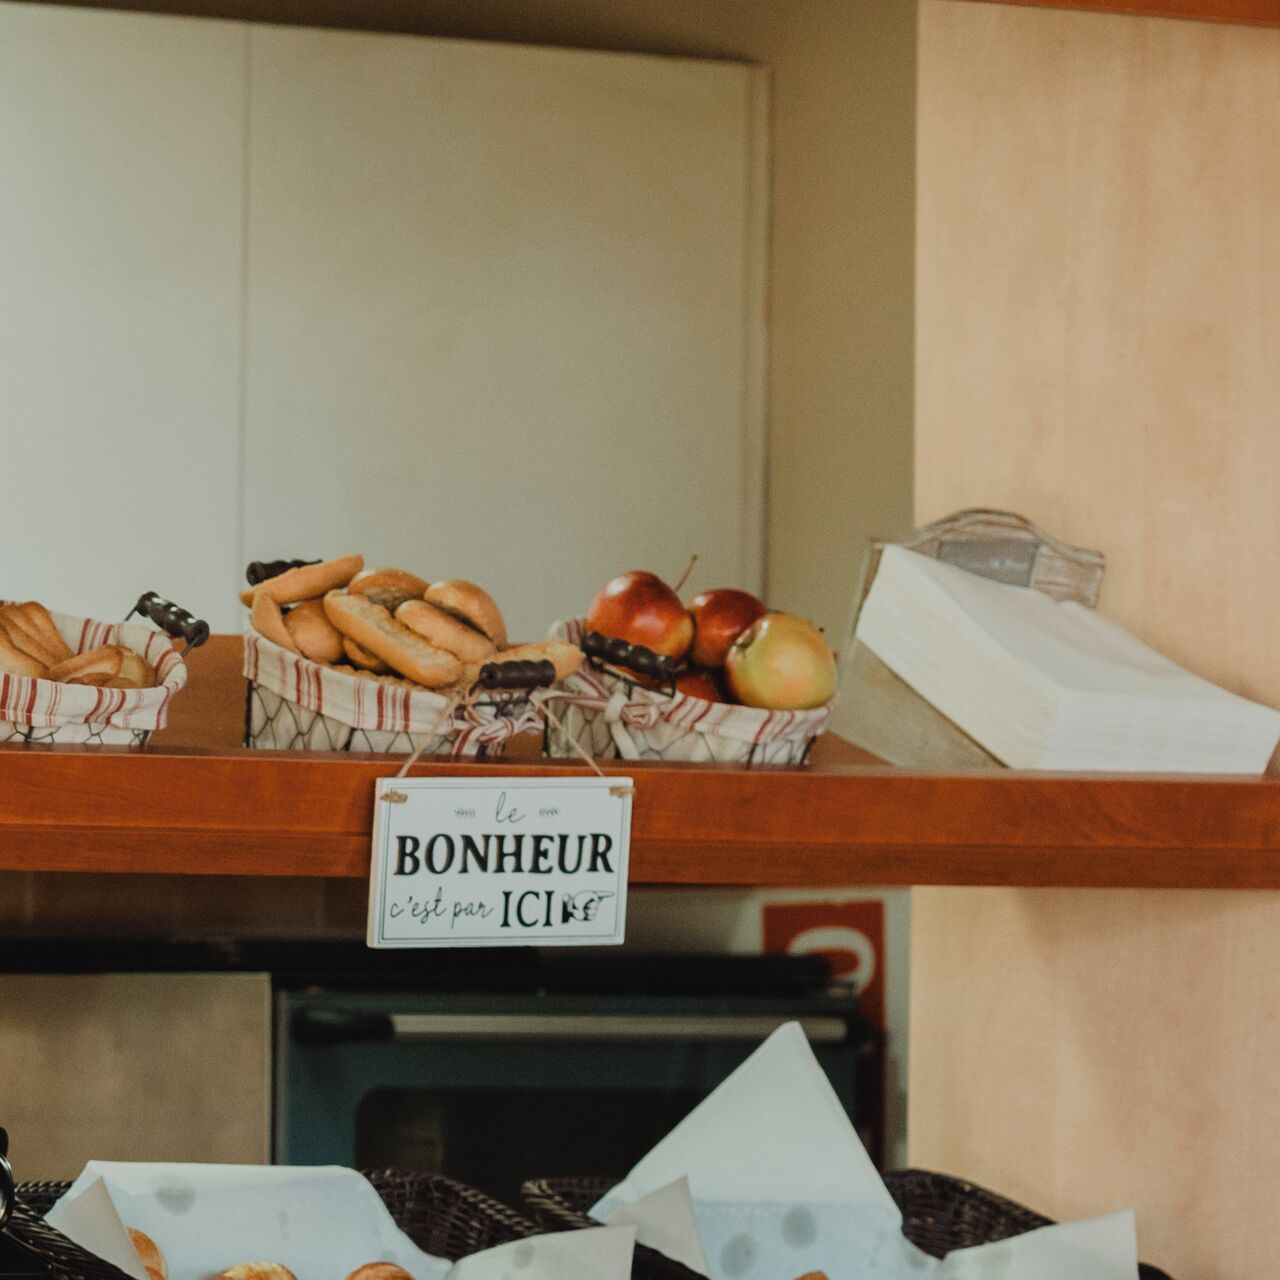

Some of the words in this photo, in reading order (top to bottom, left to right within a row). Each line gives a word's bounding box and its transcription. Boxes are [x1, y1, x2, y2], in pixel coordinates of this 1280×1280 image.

[495, 791, 526, 824] le
[393, 833, 615, 876] BONHEUR
[390, 886, 447, 924] c'est
[451, 898, 494, 928] par
[500, 890, 555, 928] ICI
